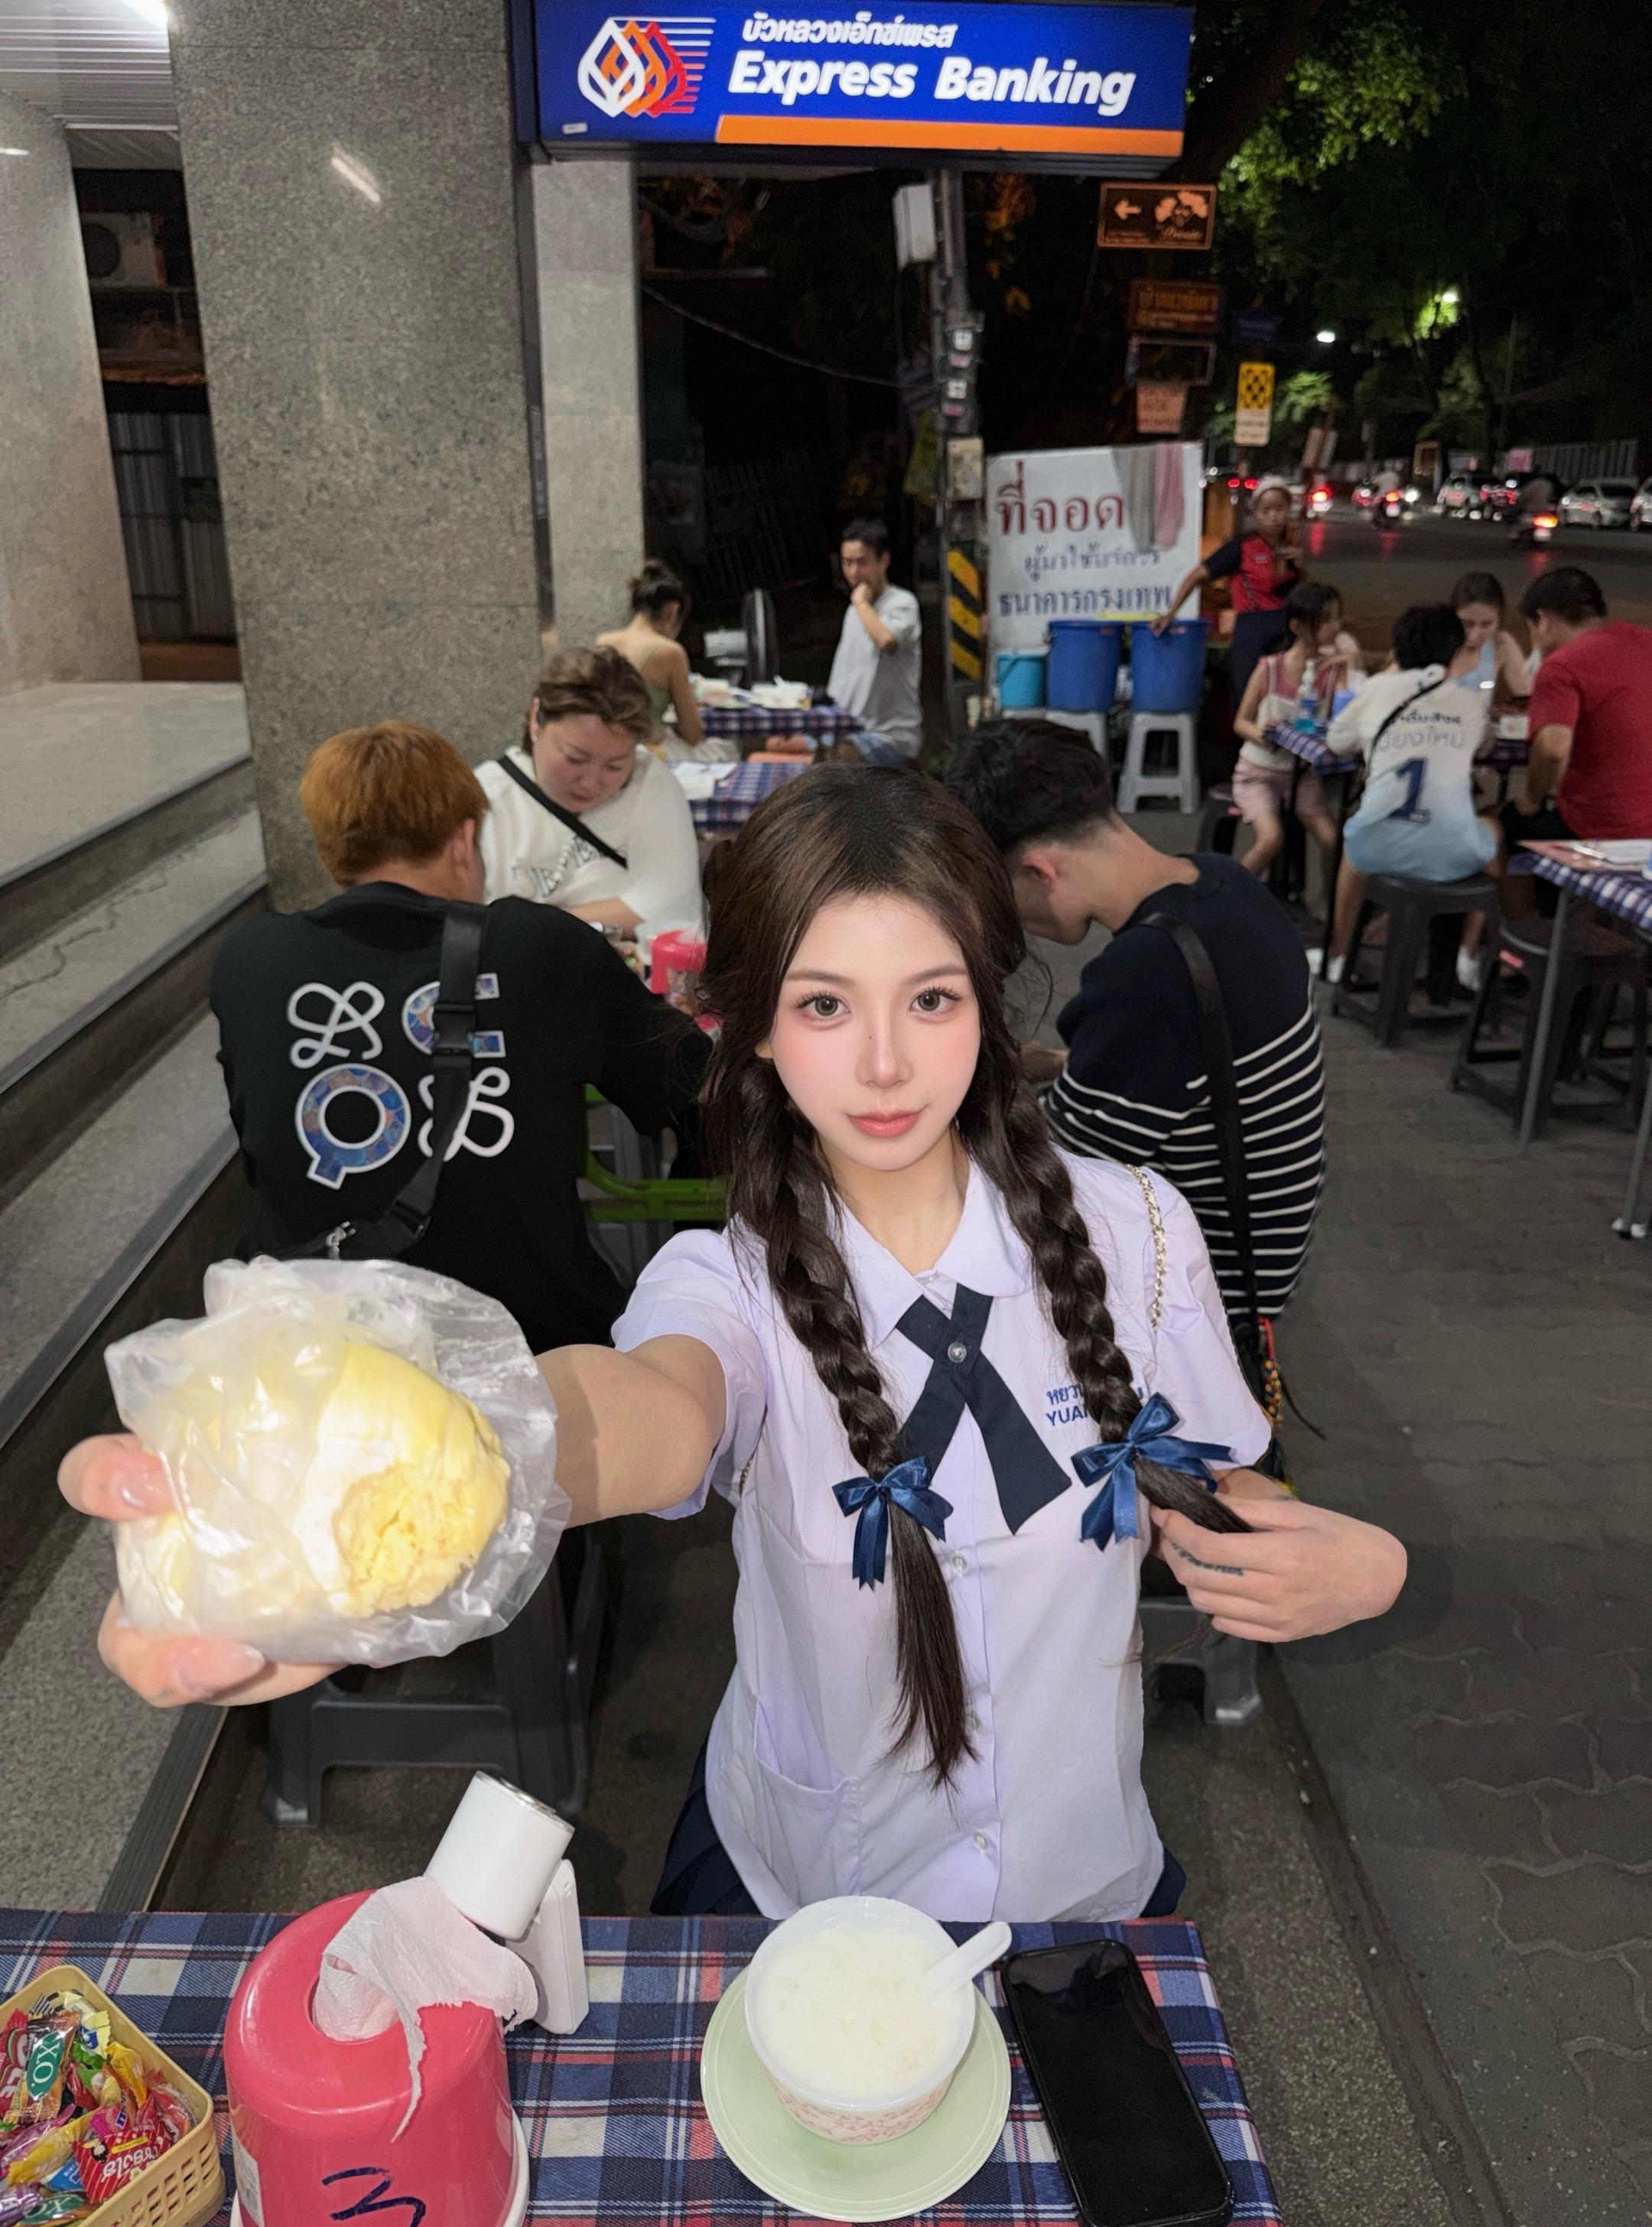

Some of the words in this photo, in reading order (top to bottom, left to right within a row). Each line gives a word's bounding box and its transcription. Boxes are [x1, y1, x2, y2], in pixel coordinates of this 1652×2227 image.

[727, 49, 919, 106] Express
[933, 56, 1137, 117] Banking
[1024, 542, 1159, 581] ผู้มาใช้บริกร
[1387, 757, 1432, 824] 1
